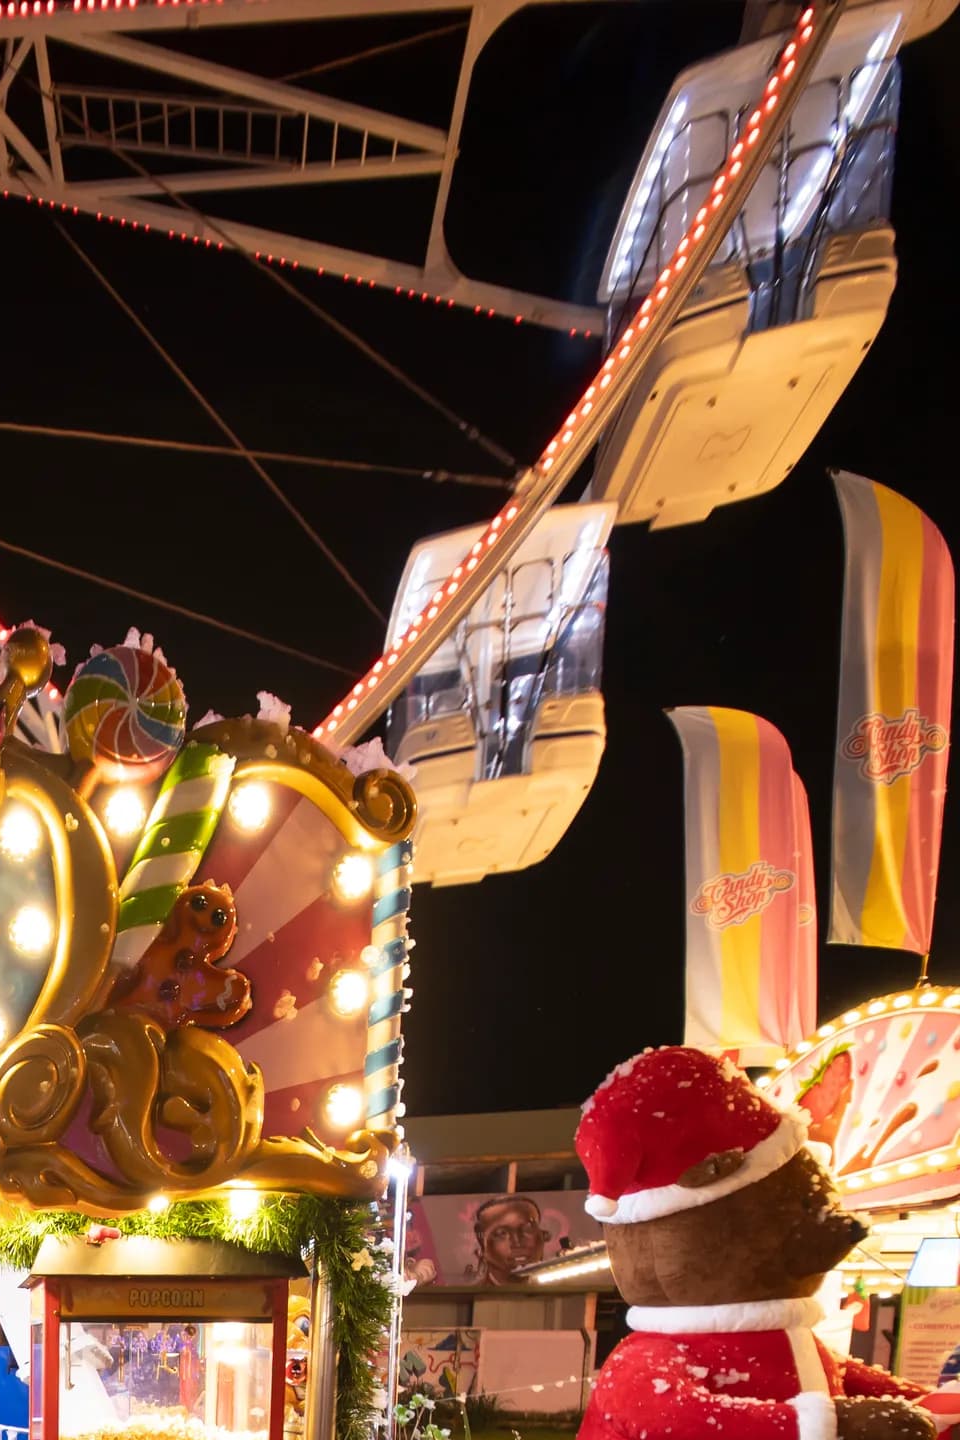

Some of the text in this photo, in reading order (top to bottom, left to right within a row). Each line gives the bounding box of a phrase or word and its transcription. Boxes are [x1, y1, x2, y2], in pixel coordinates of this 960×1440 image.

[860, 715, 924, 746] Candy
[703, 867, 773, 904] Candy
[716, 890, 767, 916] Shop
[128, 1288, 205, 1308] POPCORN
